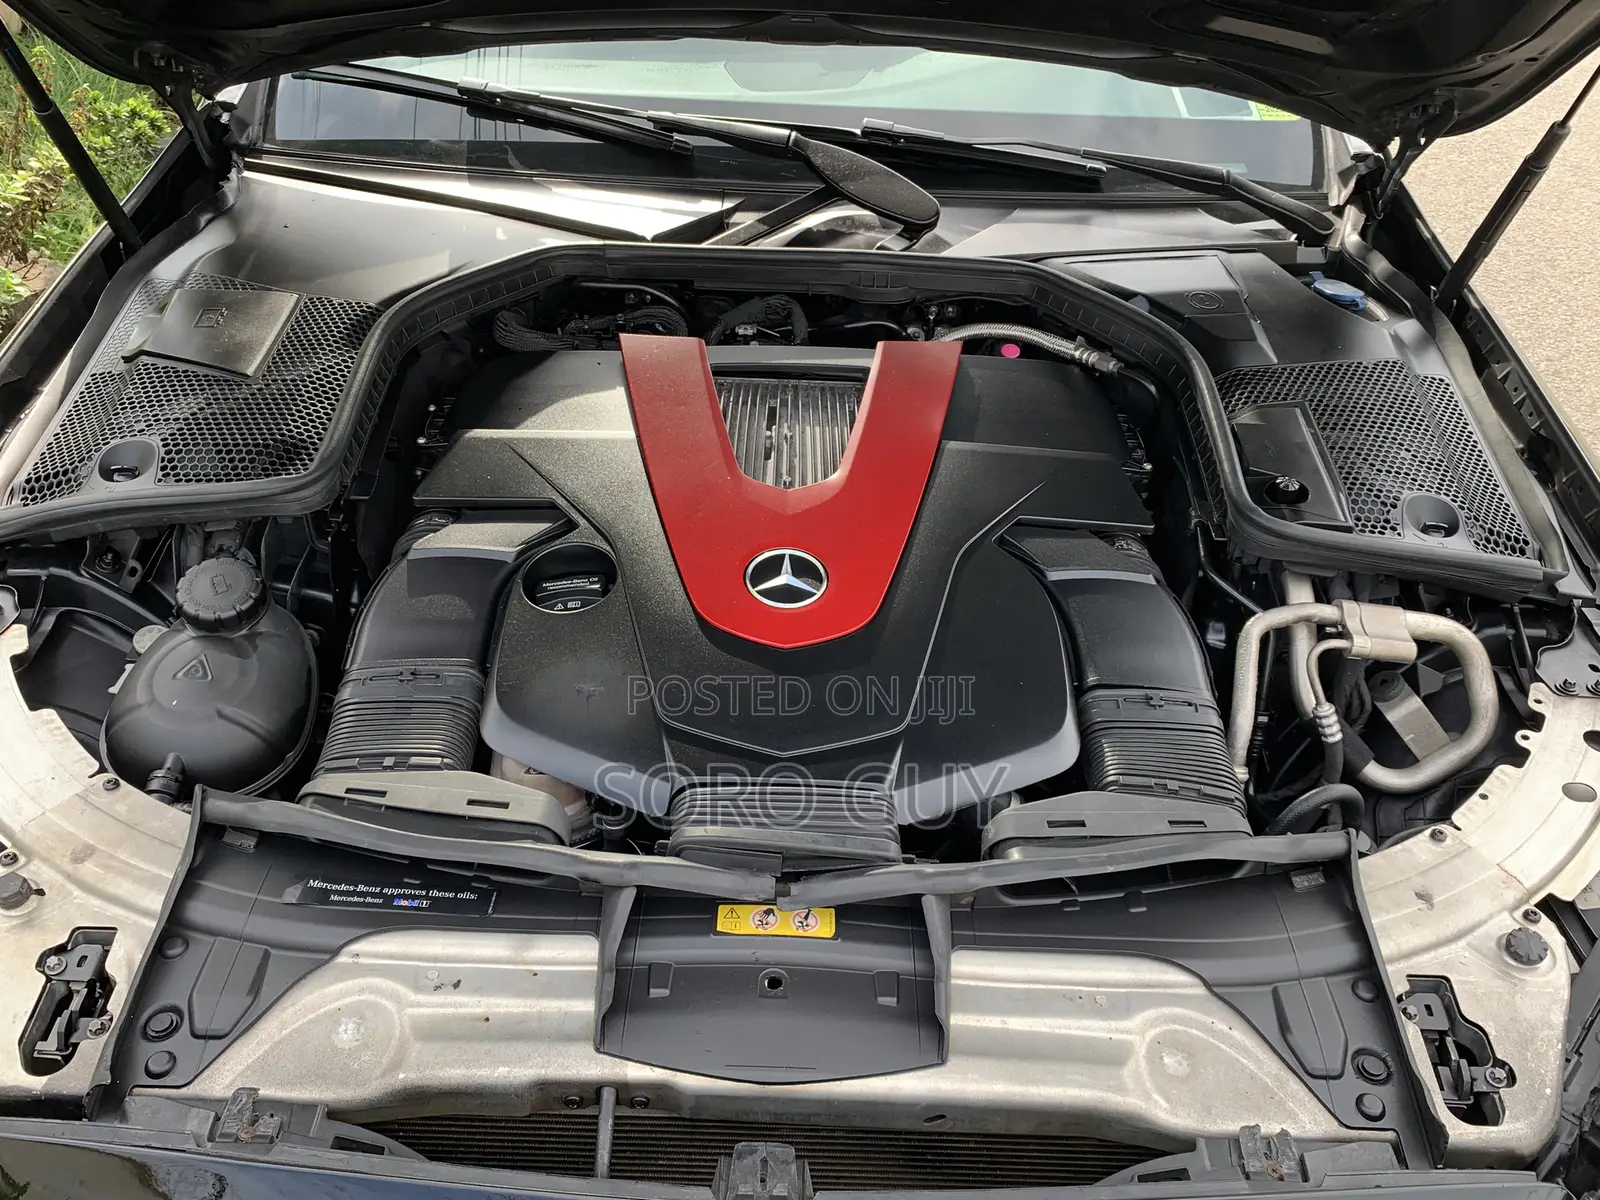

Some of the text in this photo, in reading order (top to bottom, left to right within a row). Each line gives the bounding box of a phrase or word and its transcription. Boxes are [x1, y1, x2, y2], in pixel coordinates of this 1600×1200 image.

[542, 579, 588, 587] Mercedes-Benz
[547, 582, 589, 590] recommended
[307, 880, 478, 900] Mercedes-Benz approves these oils:
[329, 895, 384, 904] Mercedes-Benz
[393, 898, 420, 907] Mobil
